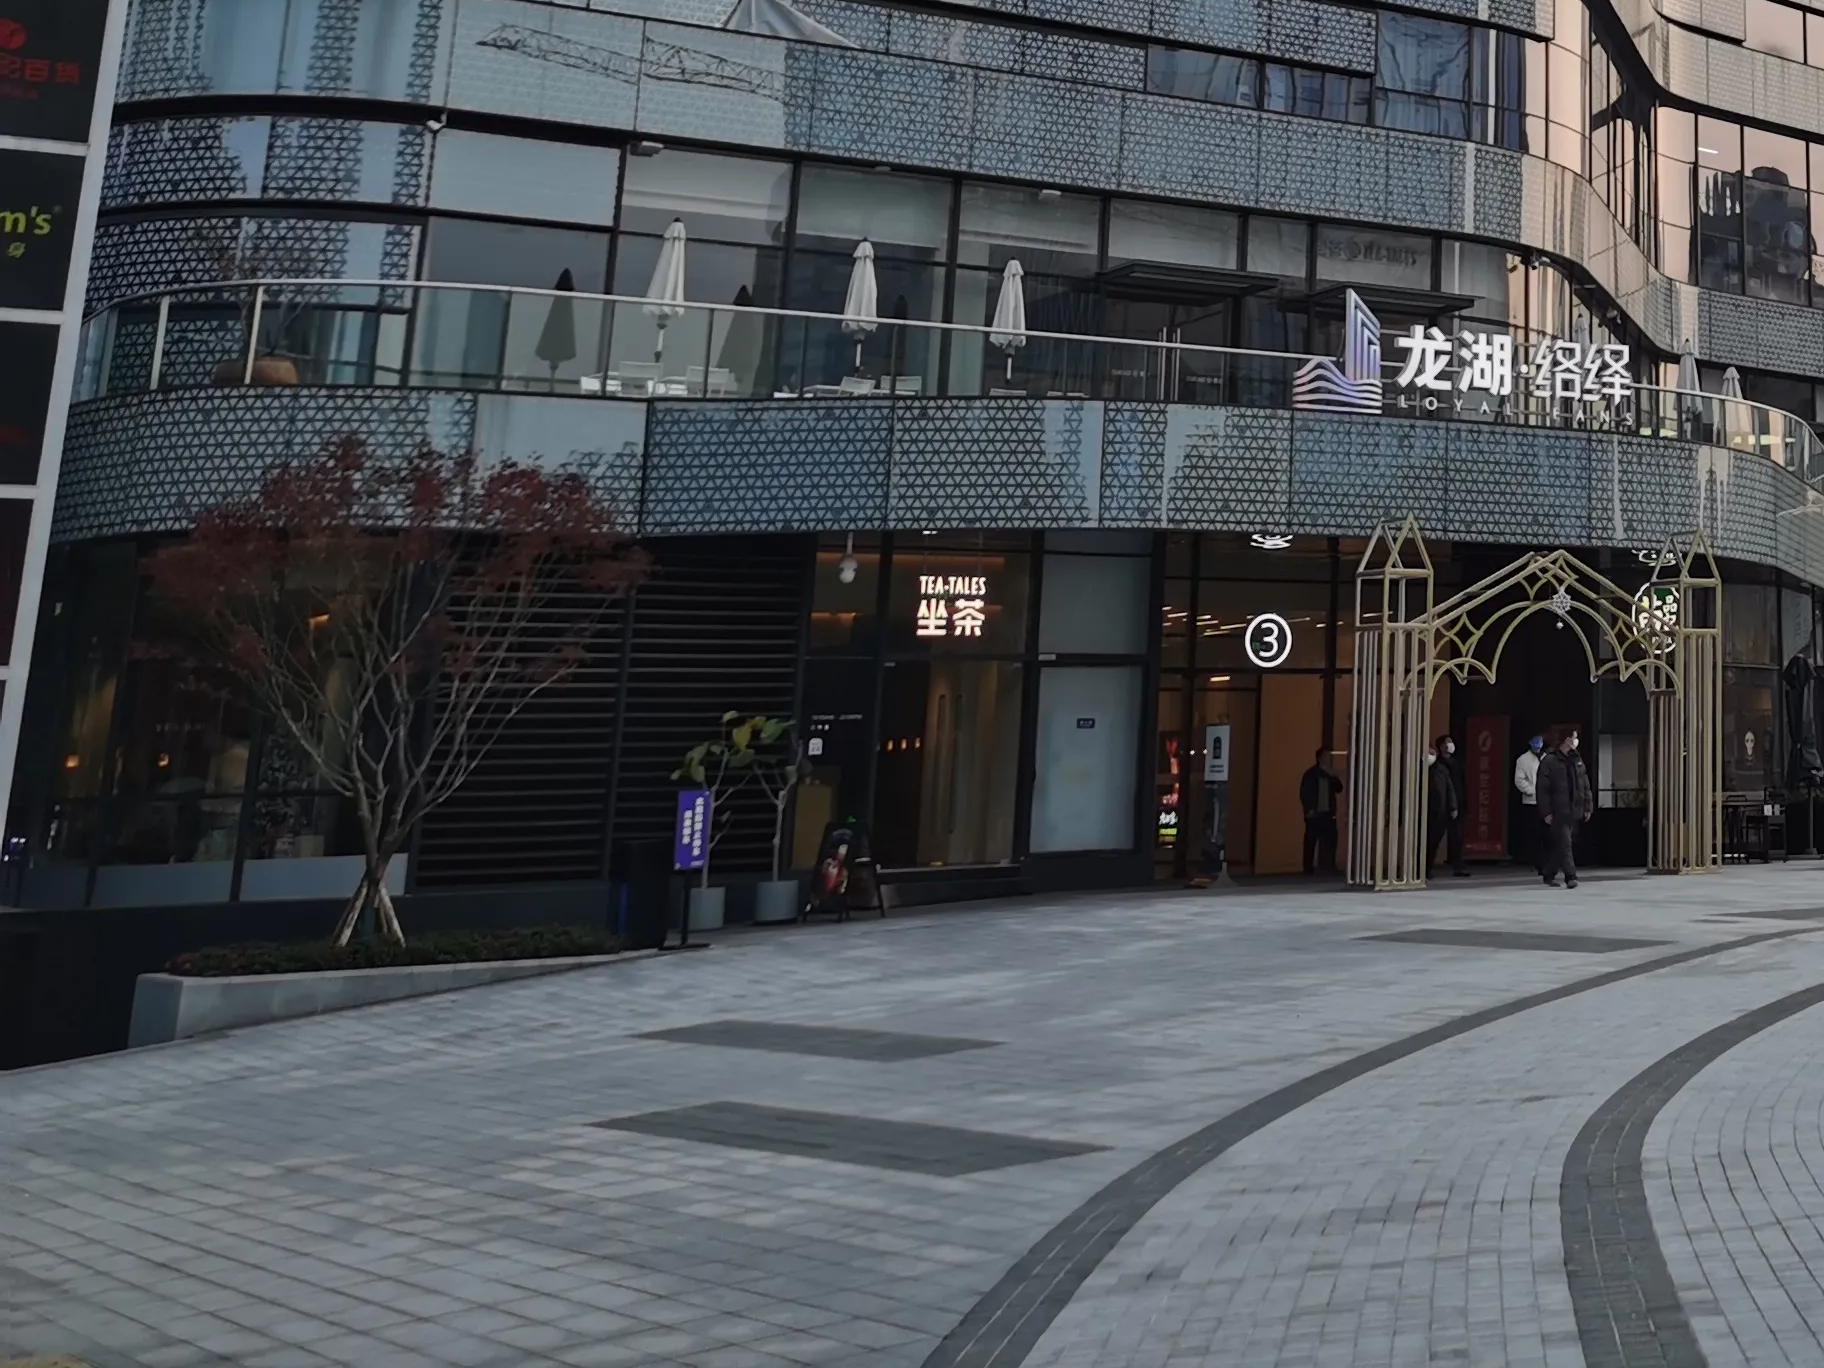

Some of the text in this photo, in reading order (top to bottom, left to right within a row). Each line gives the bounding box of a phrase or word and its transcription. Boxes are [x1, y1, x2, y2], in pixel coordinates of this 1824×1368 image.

[1398, 394, 1634, 427] LOYAL FANS
[916, 597, 985, 637] 坐茶
